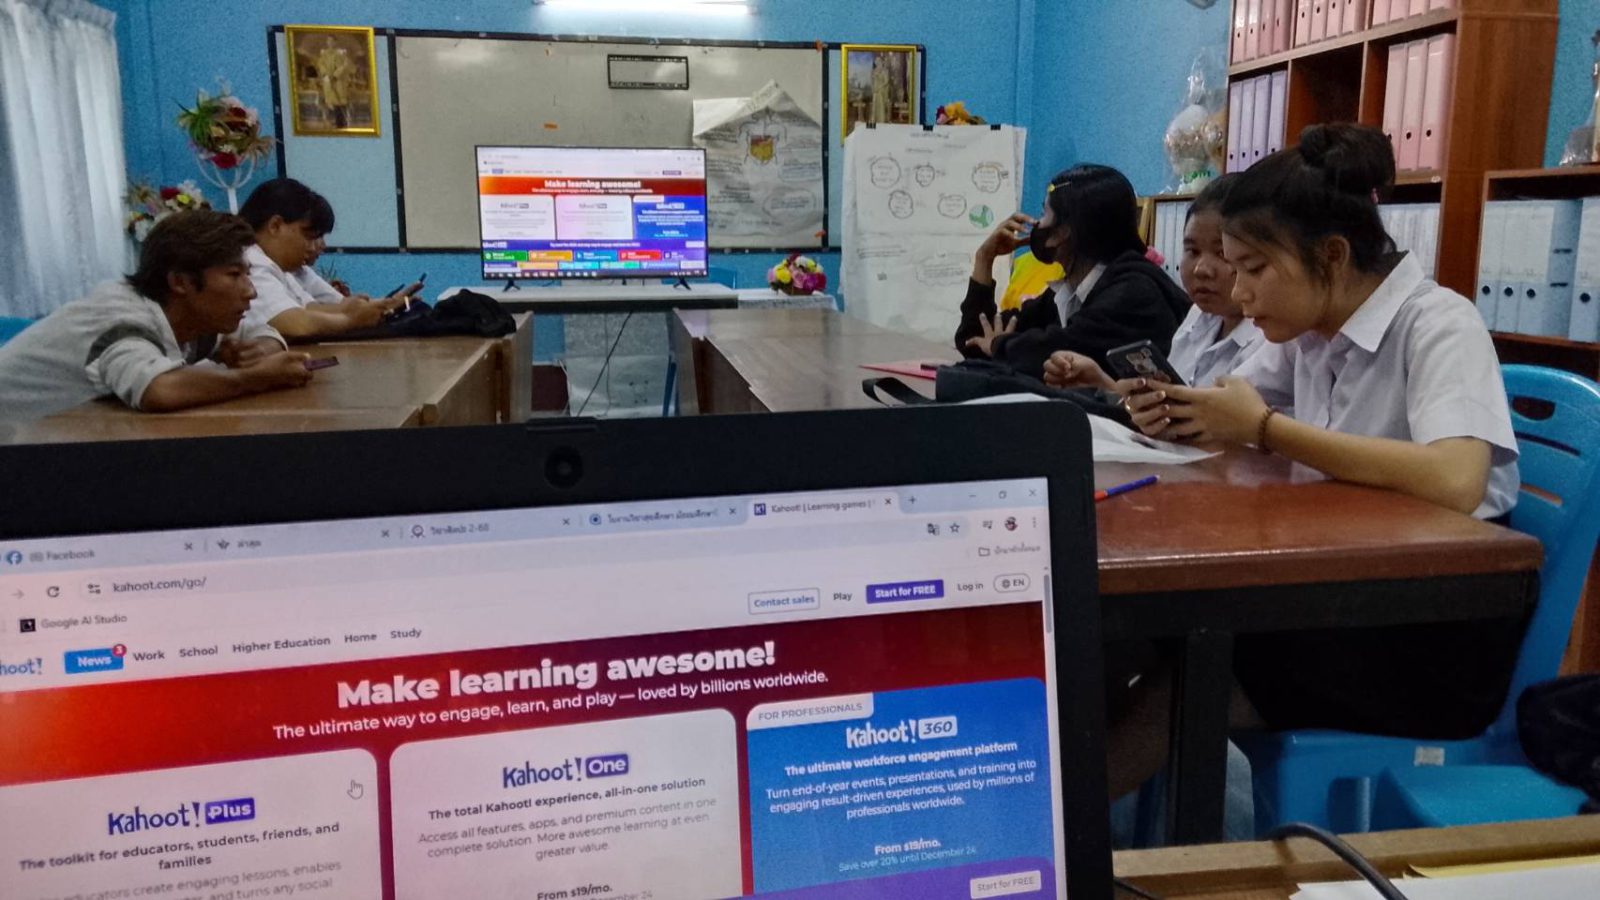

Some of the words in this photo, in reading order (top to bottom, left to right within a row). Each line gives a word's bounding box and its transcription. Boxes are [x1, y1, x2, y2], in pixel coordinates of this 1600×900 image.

[46, 549, 95, 560] Facebook
[112, 577, 207, 592] kahoot.com/go/
[957, 582, 970, 593] Log
[972, 581, 984, 590] in
[1012, 578, 1024, 586] EN
[833, 592, 852, 601] Play
[874, 588, 898, 598] Start
[898, 586, 911, 596] for
[912, 584, 935, 595] FREE
[753, 597, 792, 608] Contact
[793, 594, 816, 605] sales
[40, 618, 79, 629] Google
[80, 615, 92, 625] AI
[93, 614, 127, 624] Studio
[344, 633, 377, 643] Home
[390, 627, 422, 639] Study
[116, 645, 123, 655] 3
[179, 645, 218, 657] School
[232, 642, 271, 653] Higher
[273, 637, 331, 649] Education
[78, 656, 112, 668] News
[132, 650, 165, 661] Work
[337, 675, 440, 708] Make
[449, 658, 599, 696] learning
[606, 641, 776, 683] awesome!
[272, 724, 305, 739] The
[308, 717, 380, 735] ultimate
[382, 714, 416, 728] way
[418, 711, 437, 724] to
[439, 705, 504, 722] engage,
[506, 700, 550, 714] learn,
[552, 693, 582, 710] and
[585, 691, 617, 709] play
[637, 683, 677, 700] loved
[679, 682, 698, 699] by
[700, 678, 751, 694] billions
[752, 670, 828, 688] worldwide.
[758, 711, 779, 720] FOR
[781, 702, 862, 718] PROFESSIONALS
[846, 719, 918, 748] Kahoot!
[922, 720, 952, 735] 360
[784, 765, 805, 776] The
[806, 760, 852, 773] ultimate
[853, 754, 906, 768] workforce
[907, 748, 973, 762] engagement
[974, 742, 1017, 756] platform
[502, 757, 582, 788] Kahoot!
[589, 758, 625, 776] One
[765, 788, 790, 799] Turn
[791, 781, 849, 796] end-of-year
[957, 764, 977, 779] and
[978, 762, 1016, 774] training
[1017, 759, 1036, 772] into
[427, 809, 451, 820] The
[454, 804, 482, 817] total
[485, 798, 532, 813] Kahoot!
[534, 792, 602, 807] experience,
[604, 784, 658, 798] all-in-one
[660, 778, 705, 791] solution
[769, 799, 819, 813] engaging
[821, 791, 884, 806] result-driven
[946, 779, 971, 796] used
[972, 778, 985, 790] by
[985, 771, 1023, 787] millions
[1024, 771, 1034, 782] of
[846, 801, 911, 819] professionals
[911, 795, 965, 810] worldwide.
[107, 802, 200, 835] Kahoot!
[417, 831, 459, 843] Access
[460, 827, 474, 838] all
[560, 813, 583, 826] and
[585, 808, 636, 823] premium
[639, 802, 680, 815] content
[683, 801, 693, 809] in
[695, 798, 716, 808] one
[426, 843, 483, 858] complete
[536, 832, 566, 843] More
[568, 826, 621, 839] awesome
[623, 817, 668, 831] learning
[670, 816, 681, 826] at
[683, 813, 709, 823] even
[19, 859, 46, 870] The
[48, 852, 95, 867] toolkit
[98, 850, 118, 860] for
[121, 842, 194, 857] educators,
[197, 834, 259, 849] students,
[262, 826, 312, 840] friends,
[315, 822, 339, 834] and
[535, 846, 576, 861] greater
[874, 844, 902, 855] From
[158, 855, 211, 869] families
[133, 883, 173, 897] create
[176, 873, 239, 889] engaging
[293, 861, 342, 875] enables
[236, 885, 271, 899] turns
[273, 884, 295, 895] any
[297, 877, 333, 891] social
[536, 890, 568, 900] From
